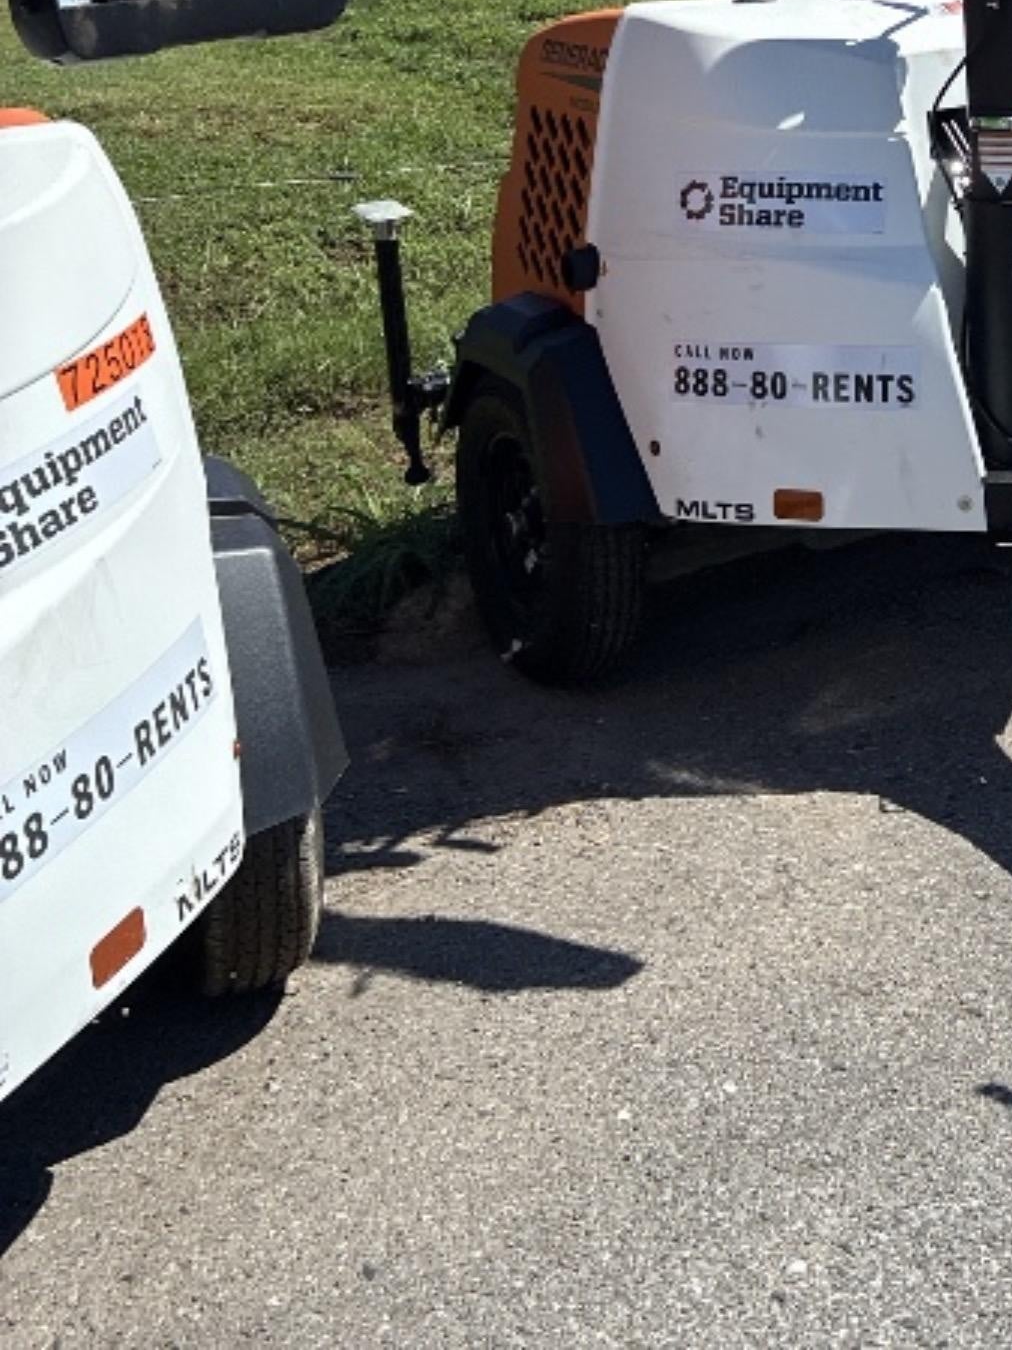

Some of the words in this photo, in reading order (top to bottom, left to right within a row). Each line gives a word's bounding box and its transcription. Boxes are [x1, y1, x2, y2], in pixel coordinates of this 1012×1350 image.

[720, 175, 884, 205] Equipment
[720, 203, 805, 227] Share
[674, 345, 712, 360] CALL
[719, 347, 754, 361] NOW
[674, 365, 915, 404] 888-80-RENTS
[676, 498, 754, 522] MLTS
[23, 749, 67, 798] NOW
